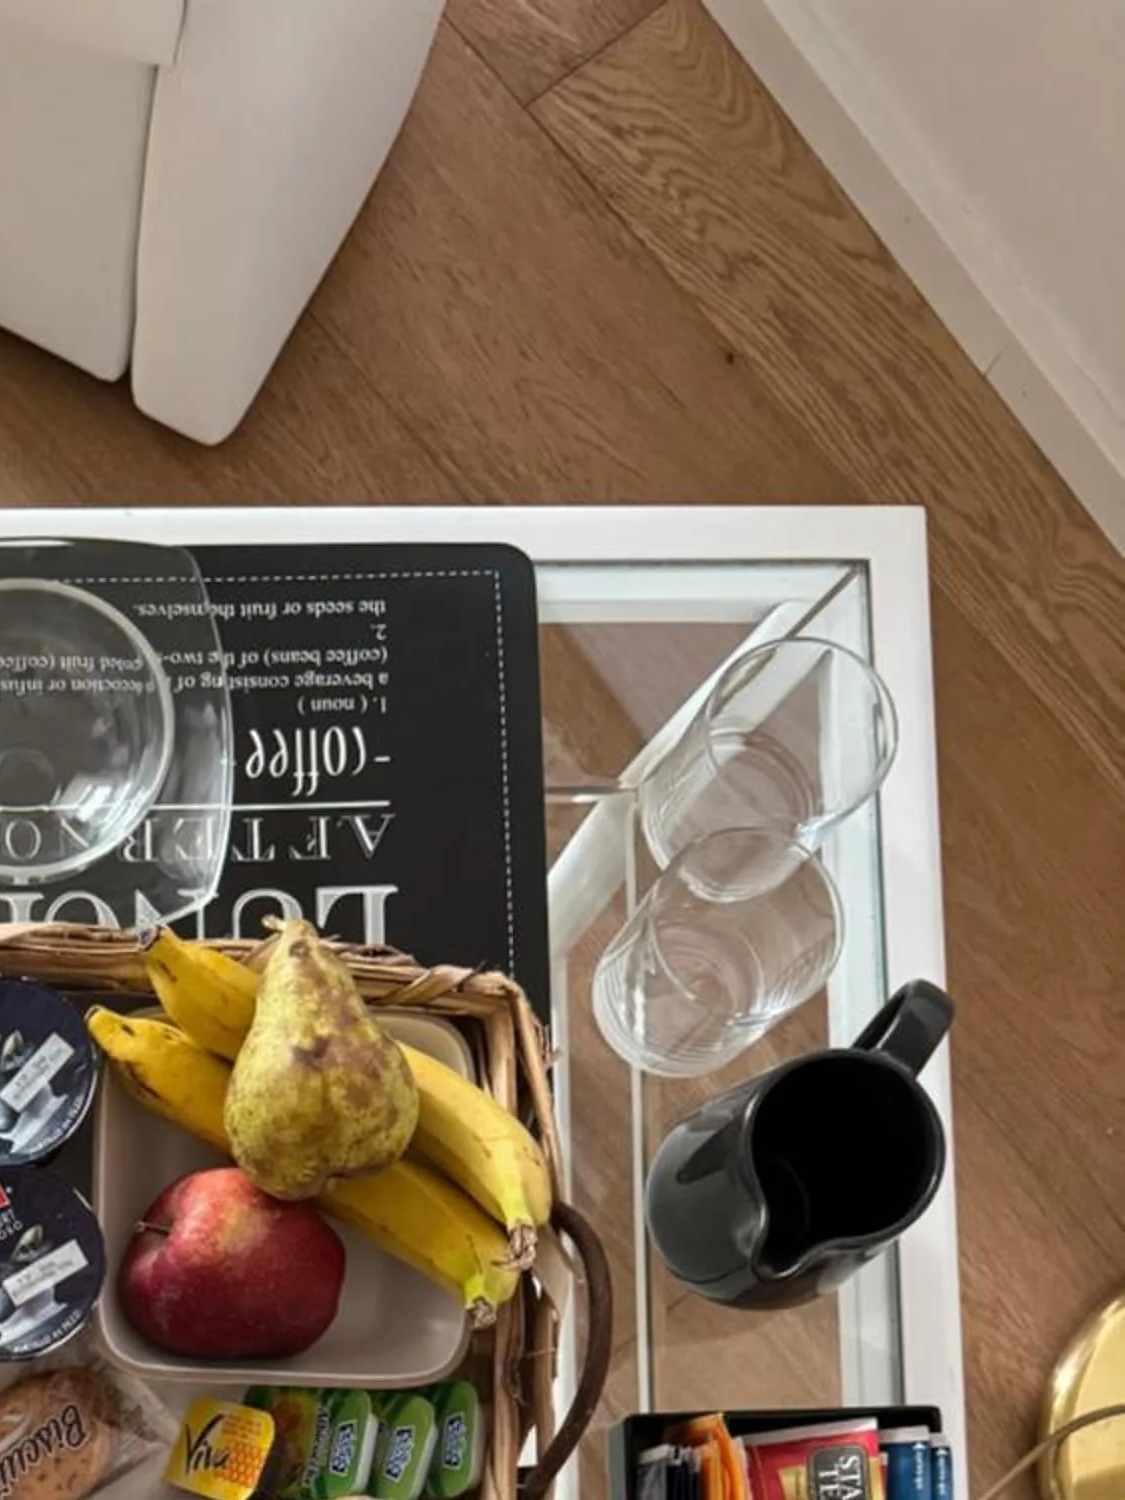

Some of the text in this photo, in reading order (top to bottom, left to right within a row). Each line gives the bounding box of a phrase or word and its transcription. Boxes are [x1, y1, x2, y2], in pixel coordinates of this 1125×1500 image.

[239, 601, 278, 618] fruit
[282, 603, 302, 614] or
[307, 601, 354, 617] seeds
[360, 600, 386, 615] the
[370, 623, 387, 640] 2.
[237, 651, 259, 668] of
[263, 650, 321, 667] beans)
[326, 648, 388, 667] (coffee
[48, 680, 66, 691] or
[177, 677, 196, 694] of
[201, 671, 291, 693] consistng
[294, 671, 374, 690] beverage
[378, 673, 389, 685] a
